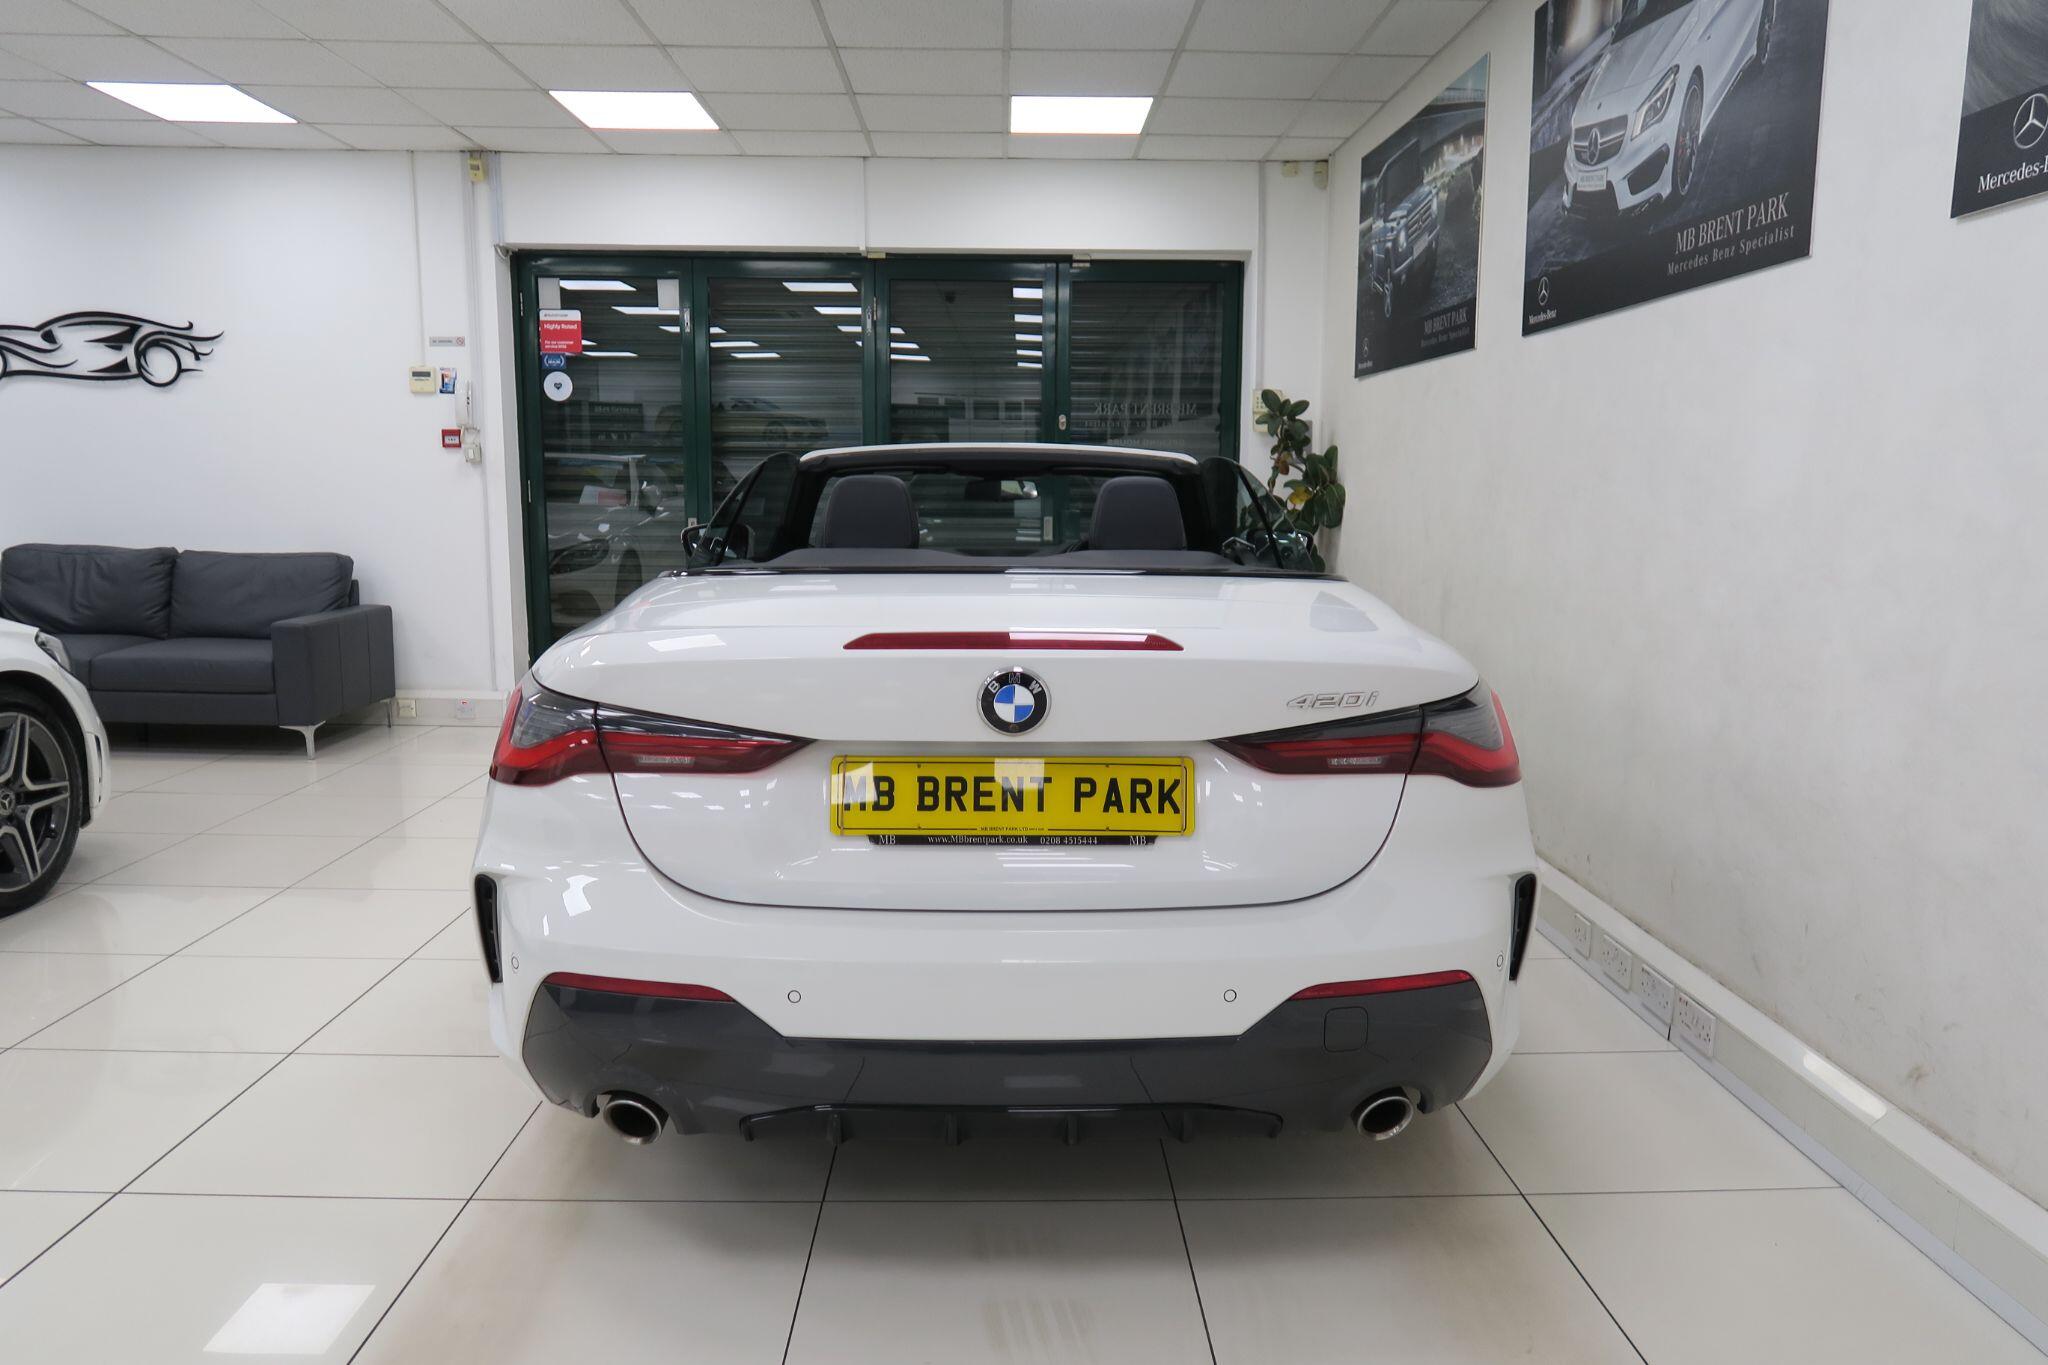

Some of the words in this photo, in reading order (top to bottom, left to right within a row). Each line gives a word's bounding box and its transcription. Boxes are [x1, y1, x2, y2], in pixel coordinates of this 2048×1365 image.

[1675, 227, 1696, 255] MB
[1698, 209, 1744, 248] BRENT
[1745, 192, 1789, 230] PARK
[1666, 254, 1709, 276] Mercedes
[1712, 245, 1736, 262] Benz
[1739, 225, 1795, 256] Specialist
[988, 672, 1042, 694] BMW
[1286, 690, 1380, 709] 420i
[844, 775, 895, 812] MB
[917, 776, 1052, 813] BRENT
[1074, 777, 1182, 815] PARK
[879, 834, 896, 845] MB
[927, 835, 1028, 845] www.MBbrentpark.co.uk
[1040, 836, 1061, 846] 0208
[1129, 835, 1147, 846] MB
